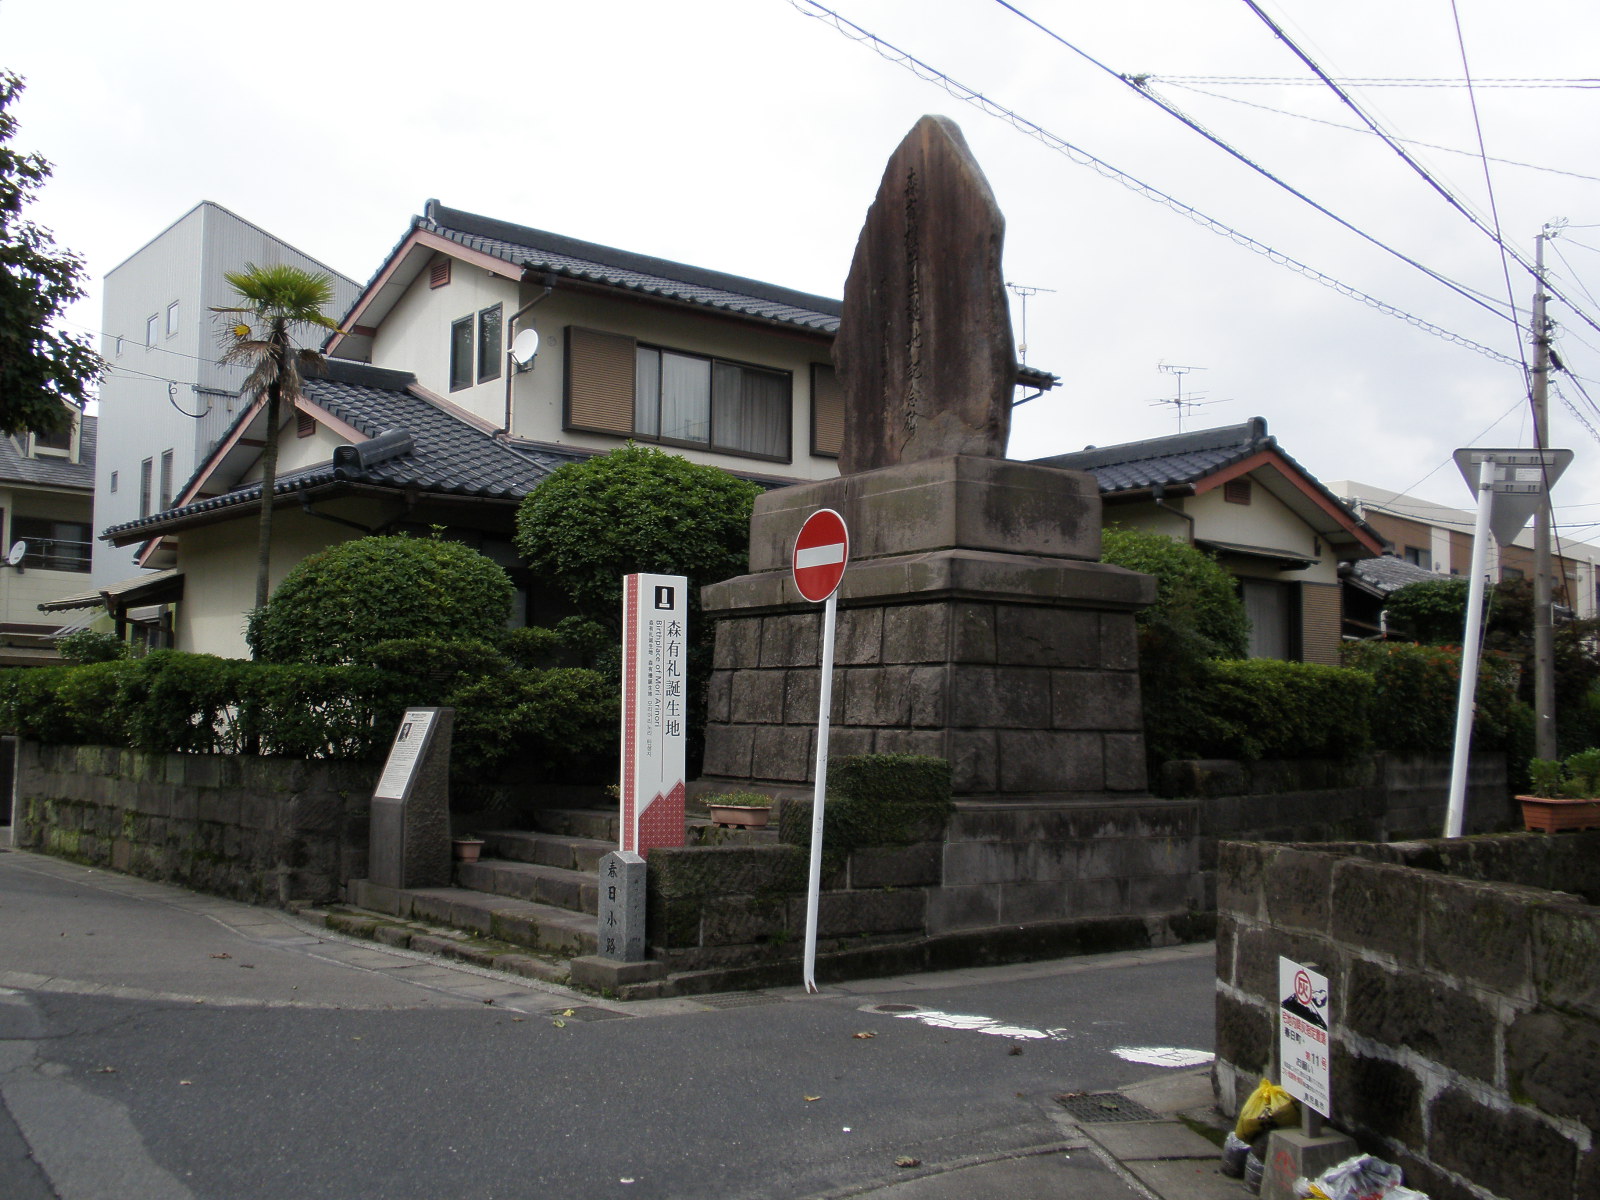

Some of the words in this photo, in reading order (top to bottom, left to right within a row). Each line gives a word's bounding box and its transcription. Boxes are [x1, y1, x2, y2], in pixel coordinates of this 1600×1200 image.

[655, 664, 662, 674] of
[666, 620, 681, 737] 森有礼誕生地
[606, 860, 617, 954] 春日小路
[1298, 976, 1308, 999] 灰
